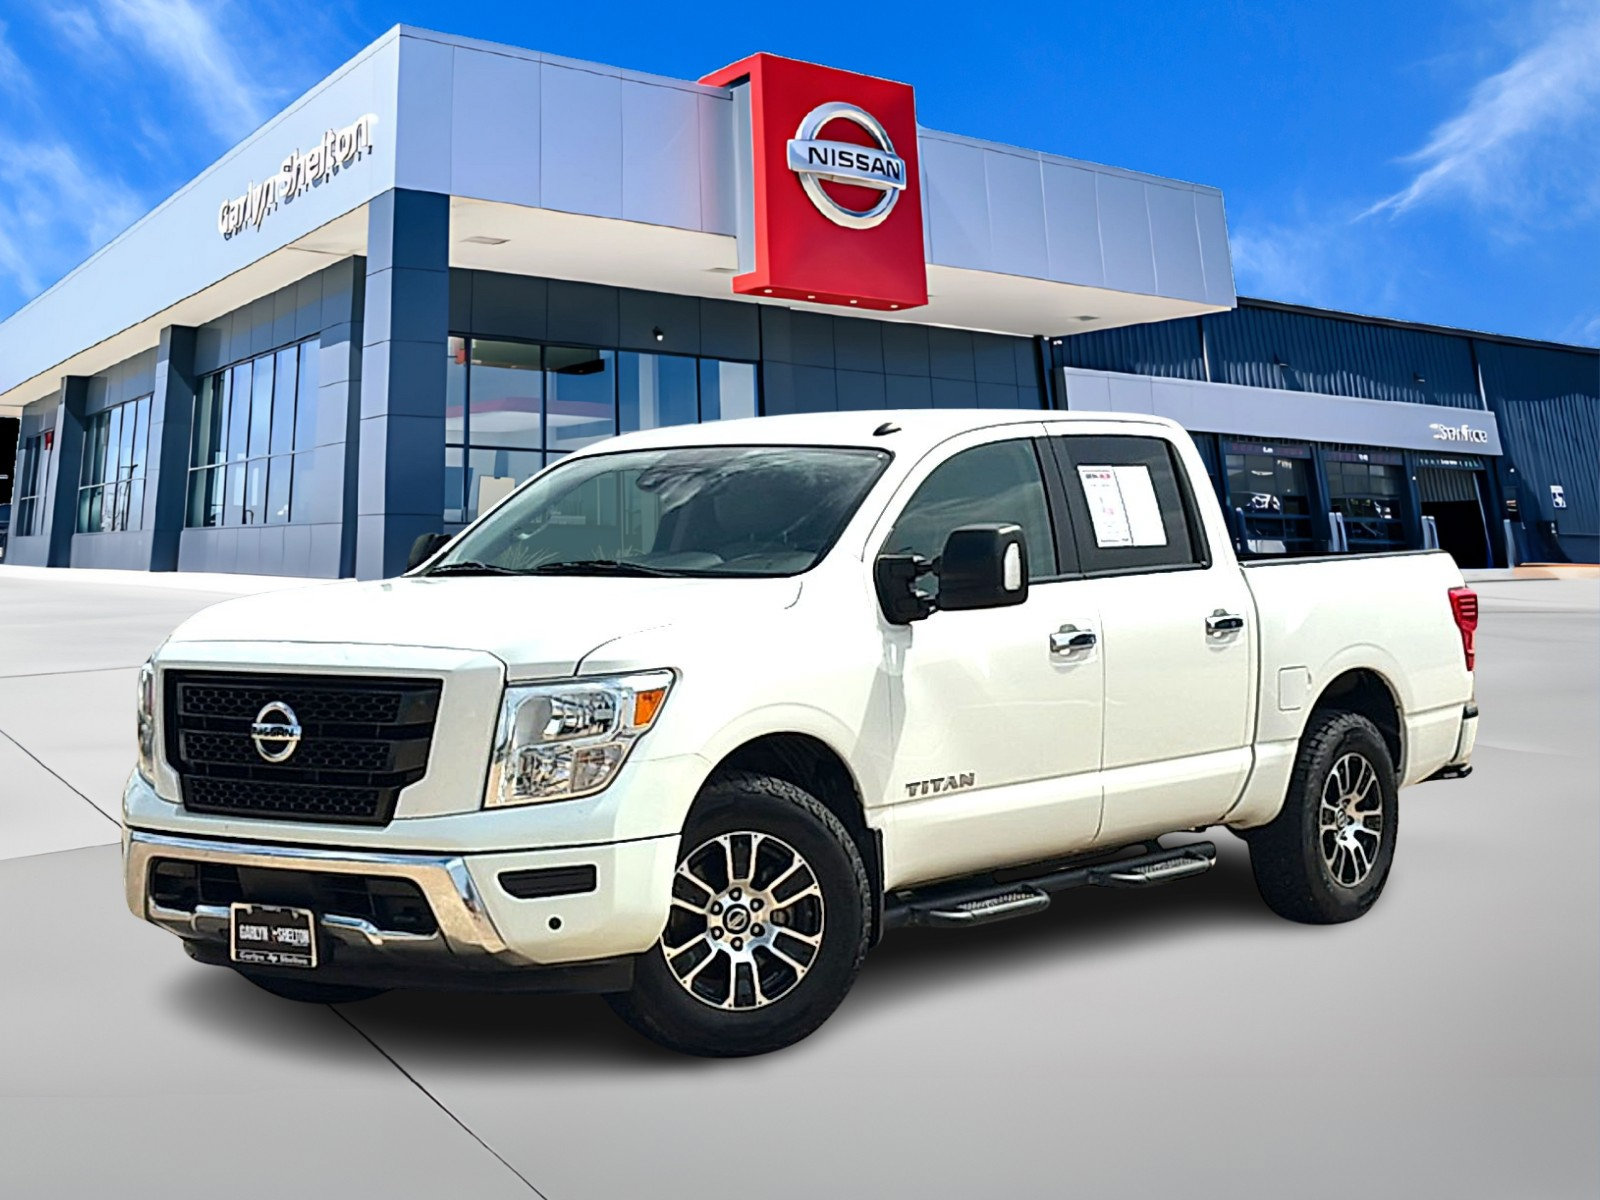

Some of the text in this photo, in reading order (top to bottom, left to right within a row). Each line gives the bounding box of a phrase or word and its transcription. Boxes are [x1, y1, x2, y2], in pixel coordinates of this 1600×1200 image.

[278, 114, 376, 204] Shelton
[808, 146, 901, 180] NISSAN
[905, 772, 975, 797] TITAN
